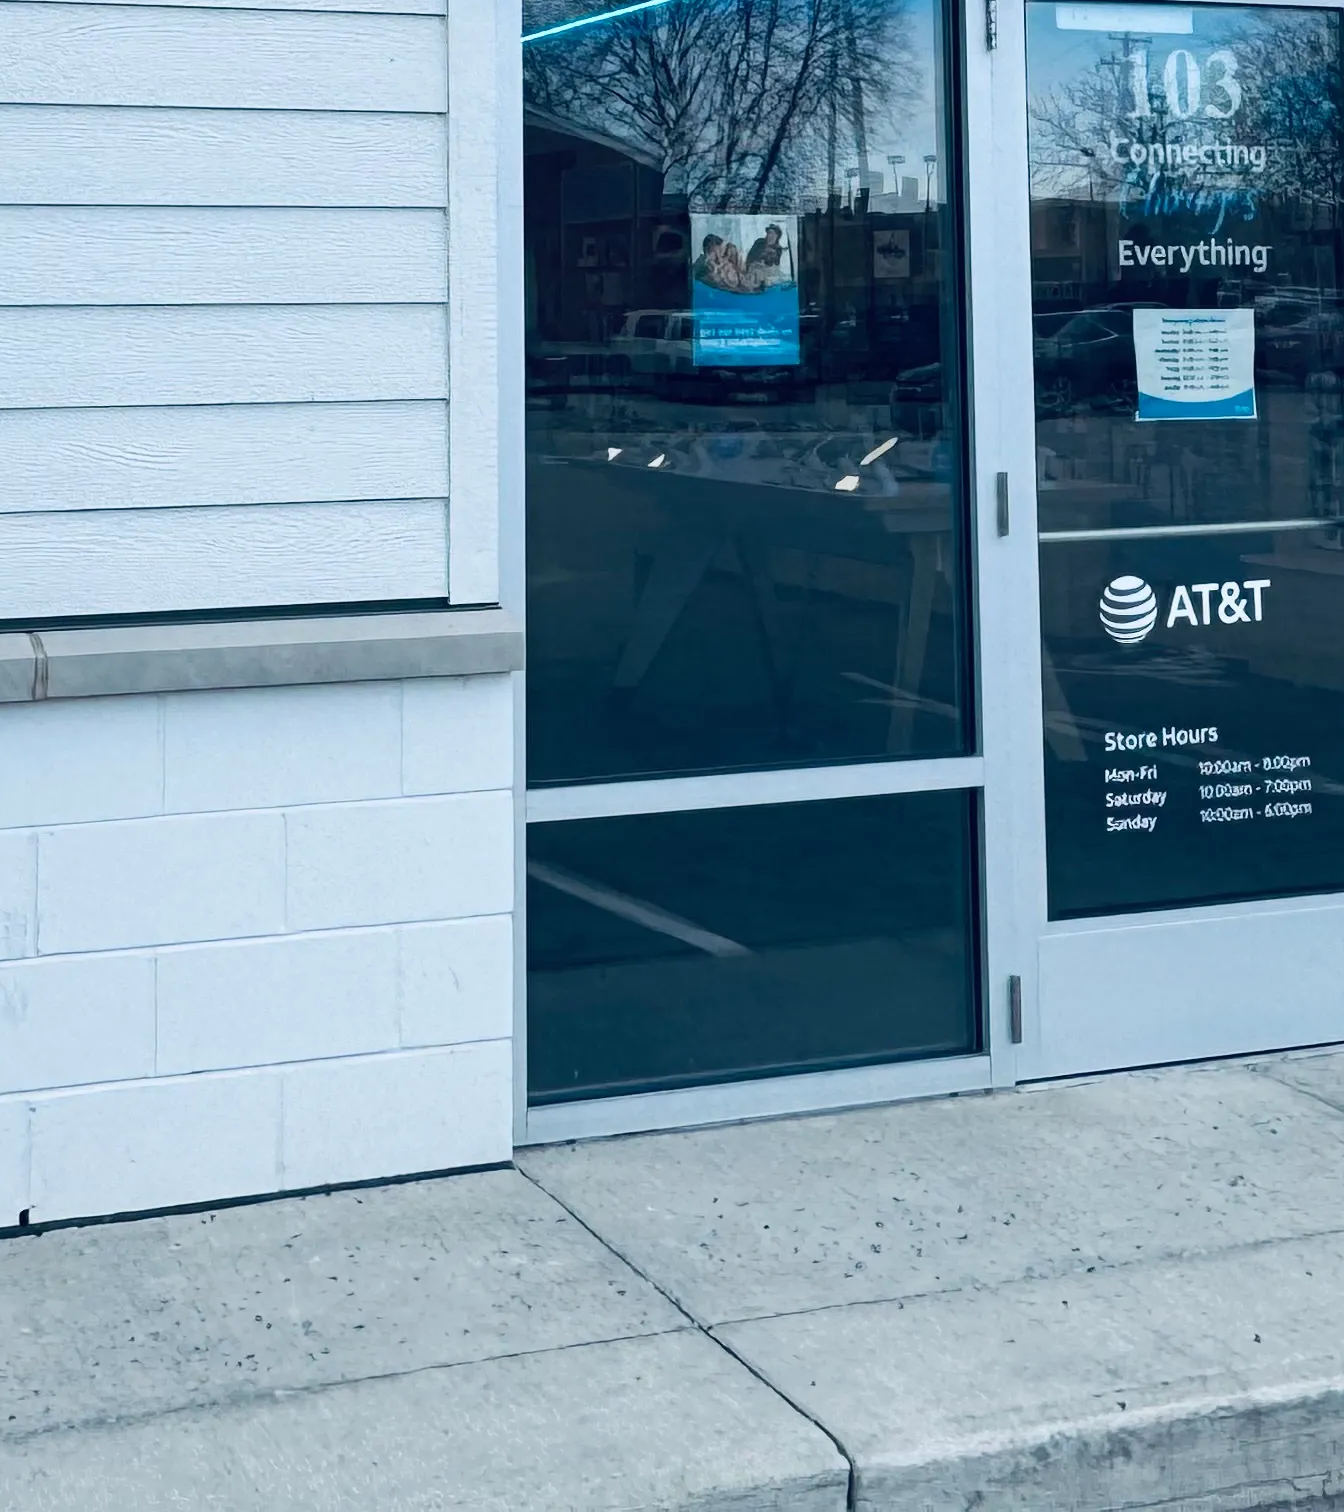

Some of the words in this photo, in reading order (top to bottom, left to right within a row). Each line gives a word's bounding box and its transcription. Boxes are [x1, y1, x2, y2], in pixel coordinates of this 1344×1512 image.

[1125, 49, 1242, 119] 103
[1109, 137, 1267, 172] Connecting
[1117, 237, 1272, 273] Everything
[1166, 579, 1271, 628] AT&T
[1105, 730, 1157, 751] Store
[1162, 726, 1219, 746] Hours
[1105, 788, 1167, 808] Saturday
[1106, 813, 1158, 832] Sunday
